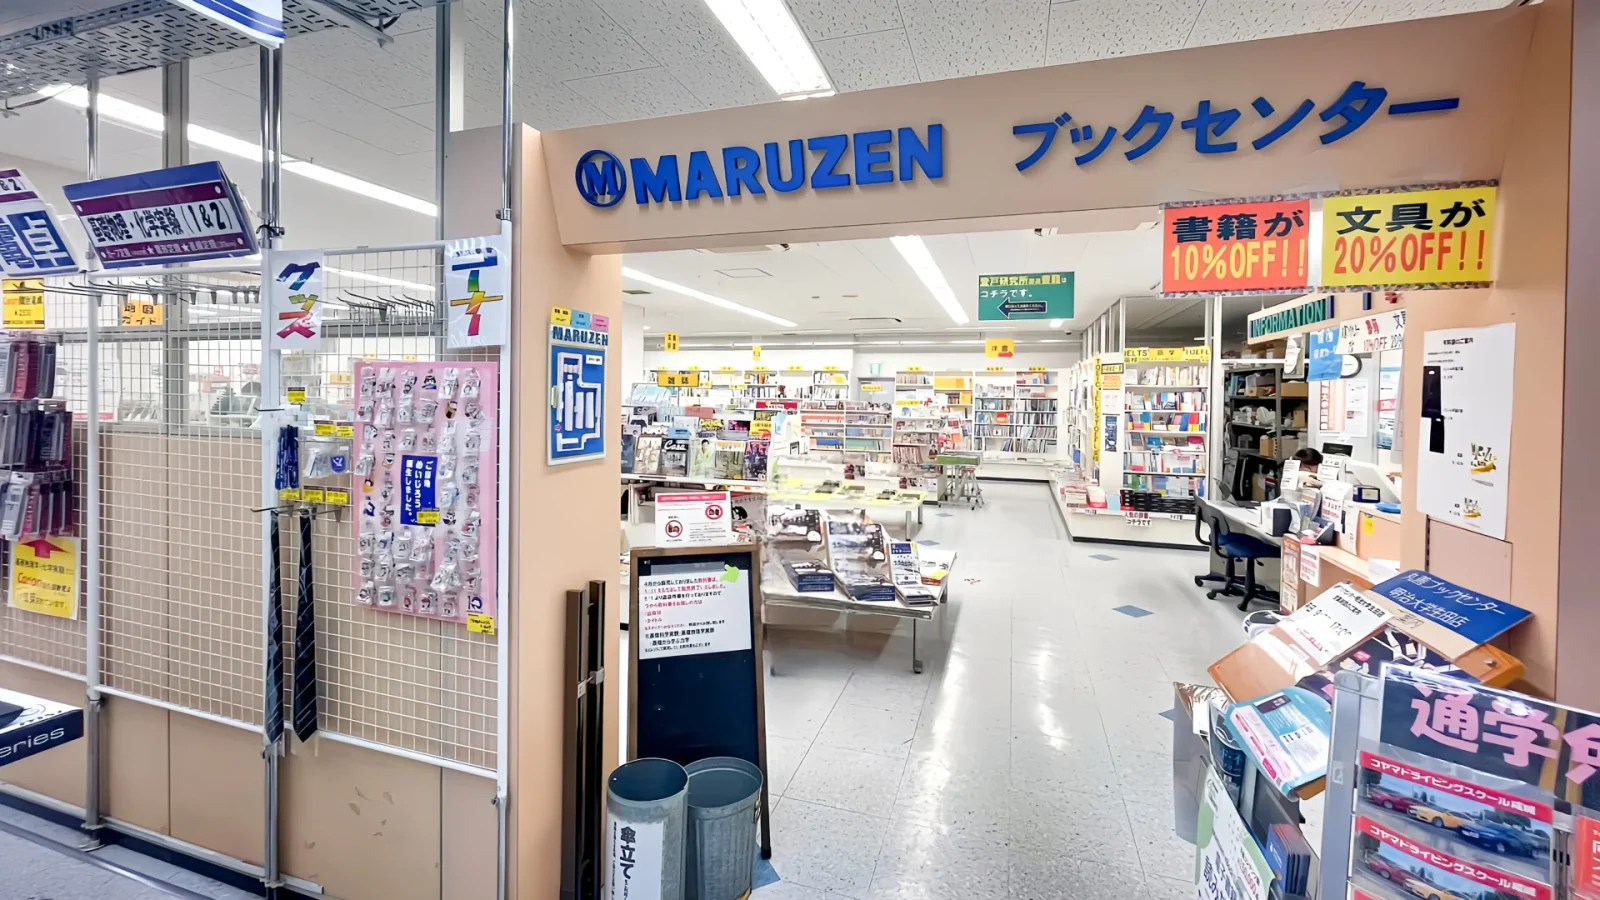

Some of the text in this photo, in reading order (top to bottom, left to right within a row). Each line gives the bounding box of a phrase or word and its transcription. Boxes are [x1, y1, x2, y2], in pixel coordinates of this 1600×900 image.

[1012, 80, 1460, 173] ブックセンター
[630, 123, 945, 205] MARUZEN
[1171, 209, 1306, 242] 書籍が
[1335, 197, 1487, 235] 文具が
[1169, 238, 1307, 282] 10%OFF!!
[1333, 229, 1487, 276] 20%OFF!!
[980, 288, 1033, 298] コチラです。
[552, 326, 609, 346] MARUZEN
[1252, 302, 1325, 338] INFORMATION
[668, 376, 689, 385] 雑誌
[414, 460, 424, 508] めいじろう
[1388, 586, 1470, 629] 明治大学生田店
[1402, 572, 1506, 616] 丸善ブックセンター
[619, 826, 637, 880] 傘立て
